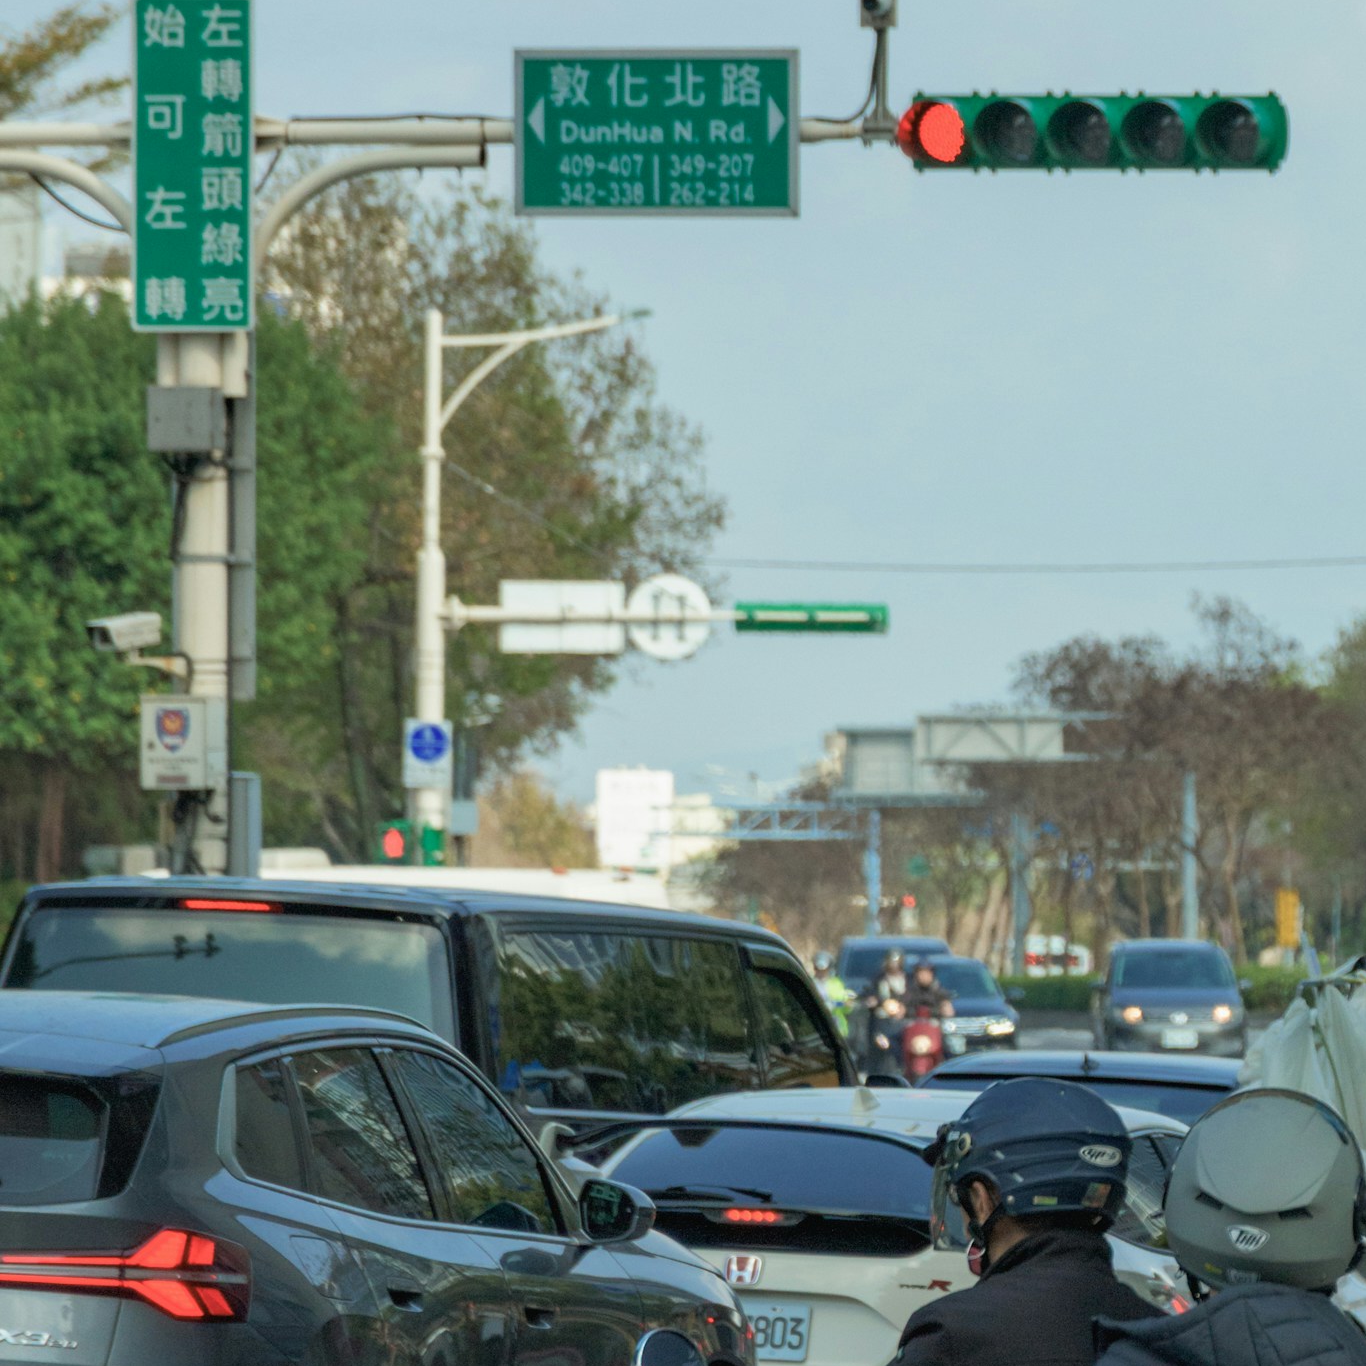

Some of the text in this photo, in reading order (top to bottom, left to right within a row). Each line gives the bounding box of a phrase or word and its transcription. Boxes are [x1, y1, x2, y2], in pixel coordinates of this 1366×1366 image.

[549, 62, 762, 108] 敦化北路
[560, 119, 752, 144] DunHua N. Rd.
[143, 3, 188, 322] 始可左轉
[201, 3, 244, 322] 左轉箭頭綠亮
[559, 153, 755, 177] 409-407 349-207
[748, 1315, 806, 1351] 803
